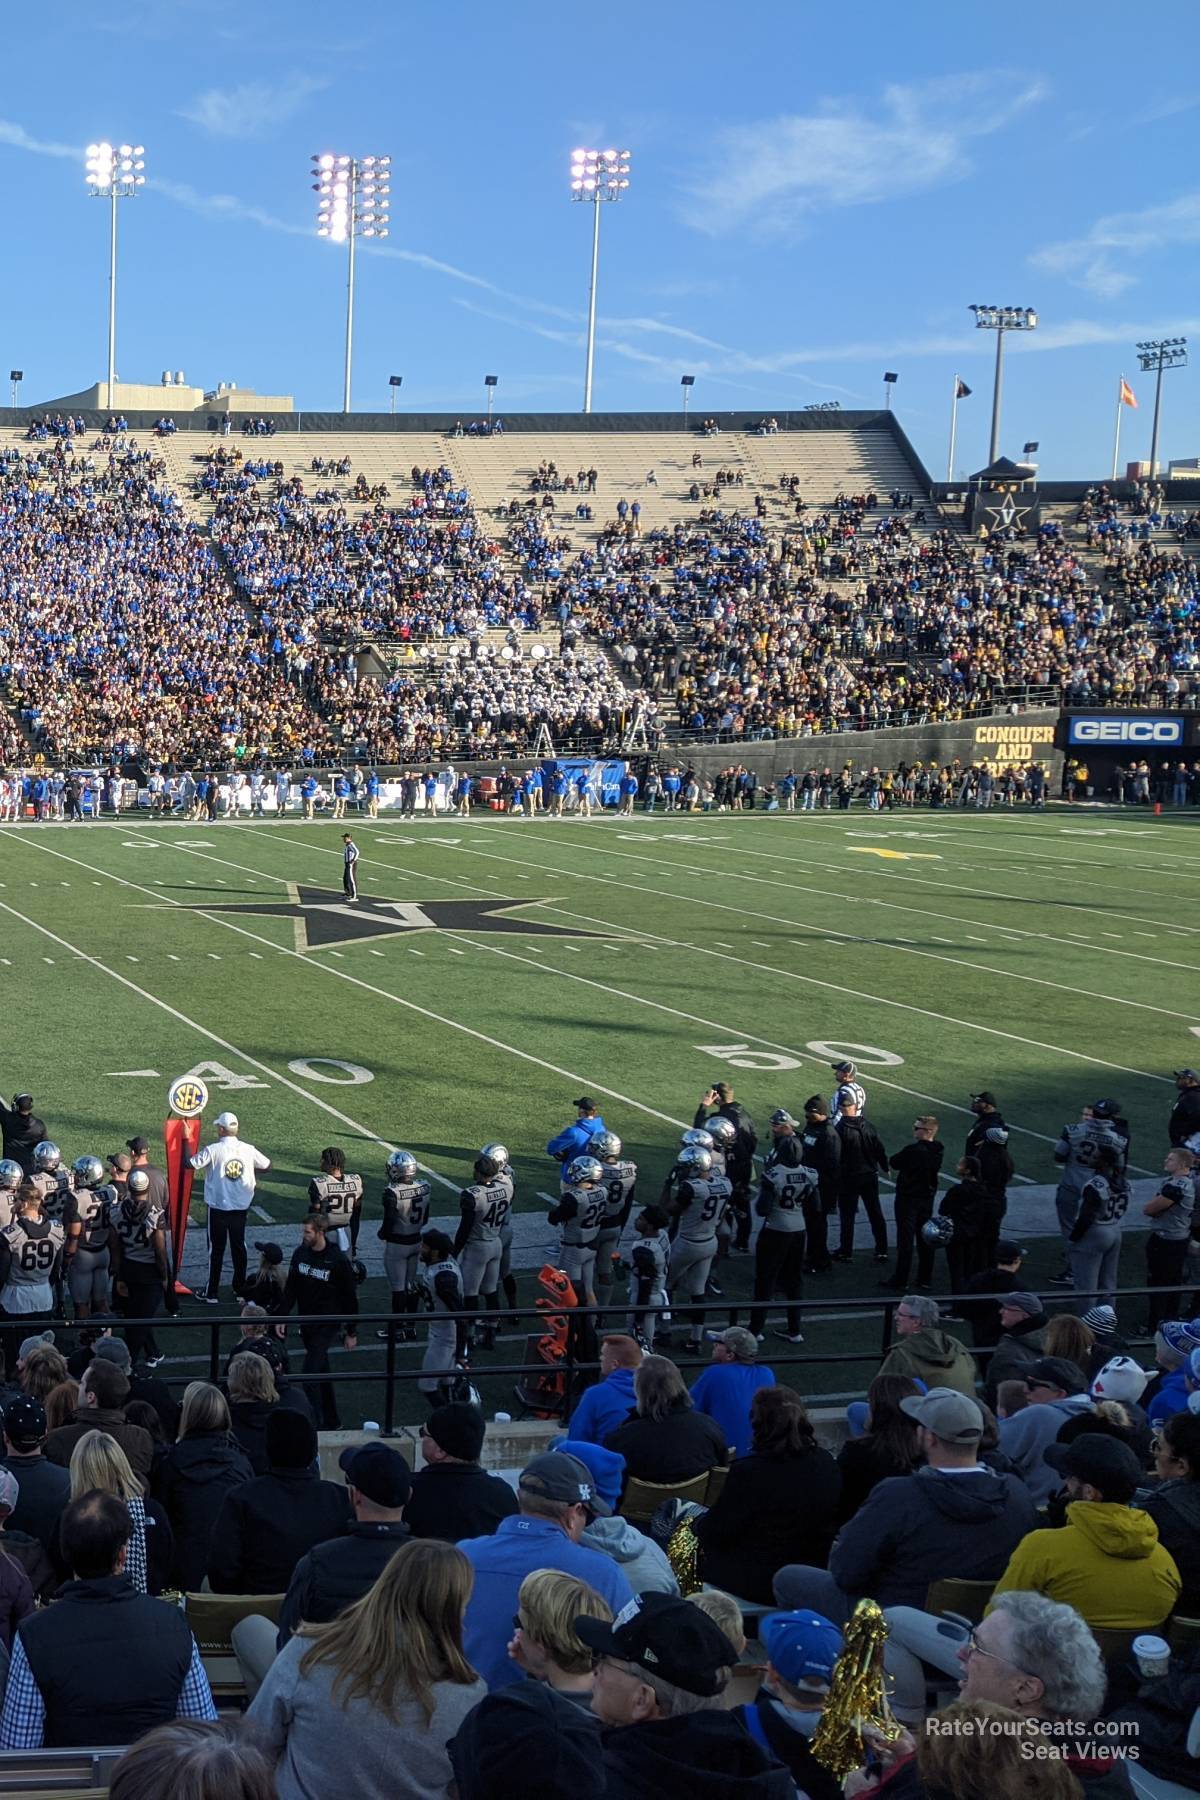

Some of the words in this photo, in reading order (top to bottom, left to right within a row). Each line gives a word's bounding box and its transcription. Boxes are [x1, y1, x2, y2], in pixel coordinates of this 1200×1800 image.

[1001, 509, 1016, 524] V
[975, 726, 1054, 743] CONQUER
[1074, 721, 1180, 741] GEICO
[995, 744, 1032, 760] AND
[296, 902, 438, 927] V
[174, 1084, 201, 1110] SEC
[225, 1162, 243, 1179] SEC
[327, 1193, 357, 1214] 20
[608, 1181, 624, 1204] 8
[780, 1184, 813, 1210] 84
[409, 1198, 423, 1225] 5
[483, 1200, 509, 1228] 42
[580, 1202, 607, 1230] 22
[701, 1195, 729, 1222] 97
[117, 1219, 150, 1248] 24
[20, 1239, 55, 1272] 69
